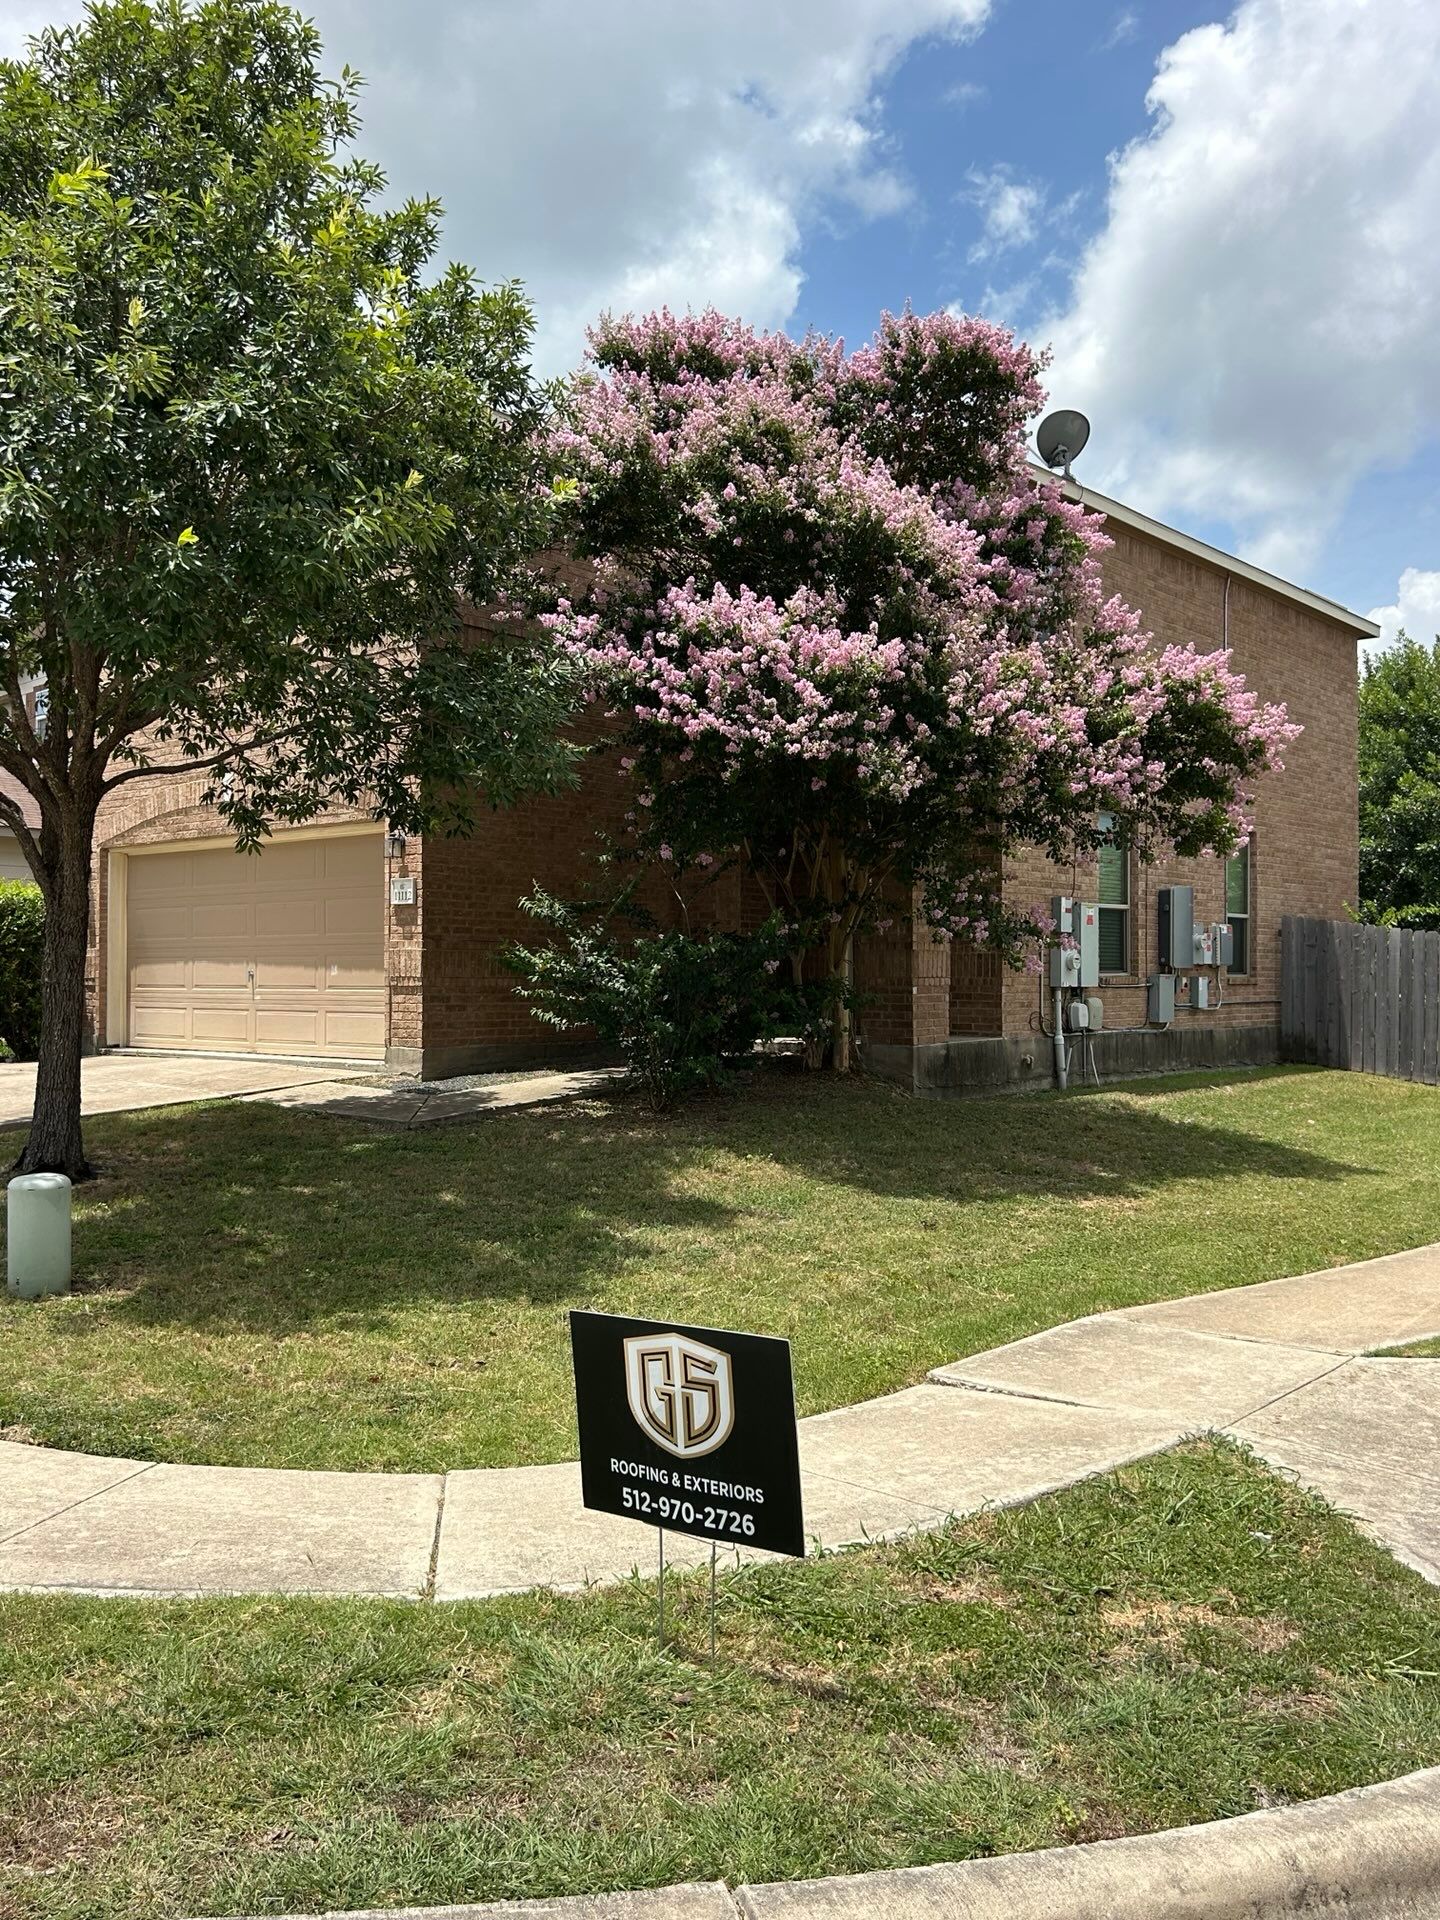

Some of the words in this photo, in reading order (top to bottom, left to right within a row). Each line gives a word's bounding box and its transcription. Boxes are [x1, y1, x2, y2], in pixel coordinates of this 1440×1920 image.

[636, 1346, 721, 1448] GS
[610, 1458, 669, 1485] ROOFING
[671, 1472, 681, 1488] &
[684, 1474, 765, 1504] EXTERIORS
[622, 1486, 756, 1536] 512-970-2726
